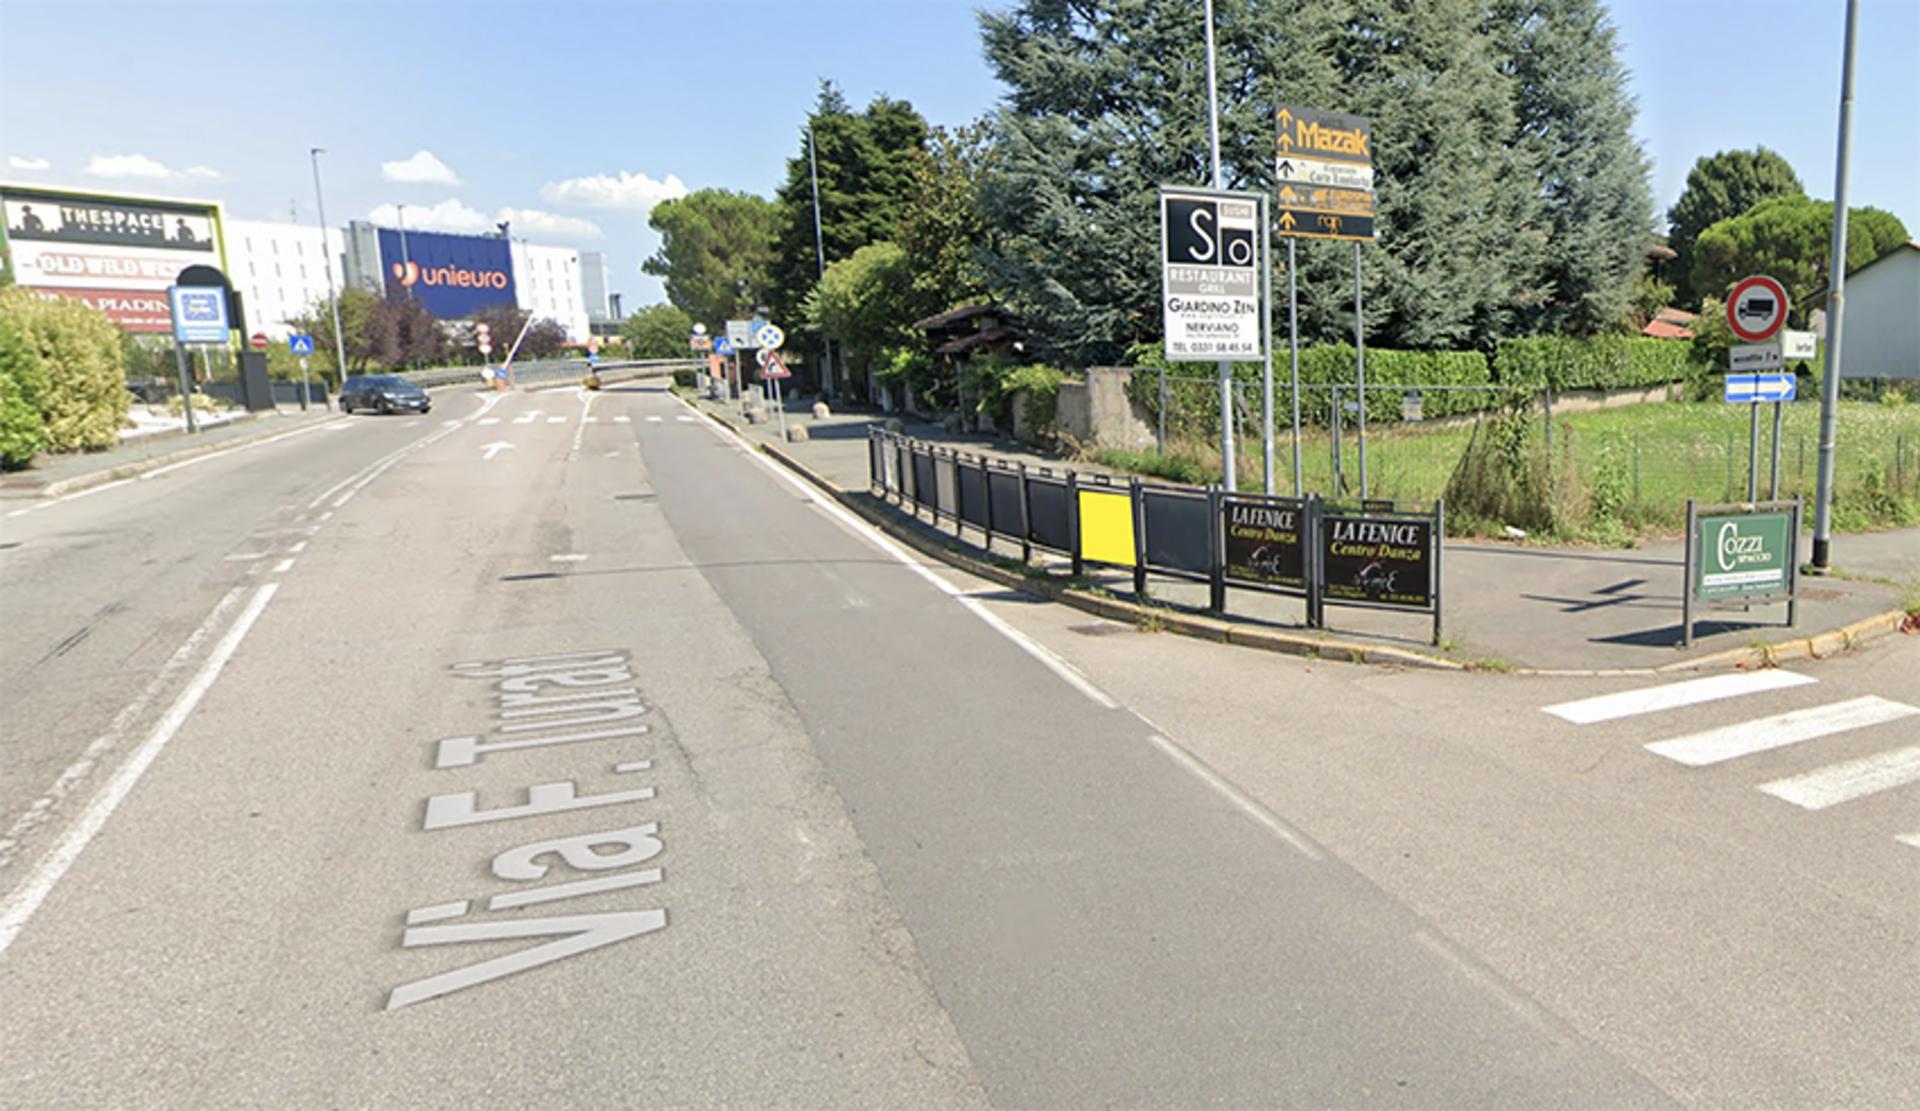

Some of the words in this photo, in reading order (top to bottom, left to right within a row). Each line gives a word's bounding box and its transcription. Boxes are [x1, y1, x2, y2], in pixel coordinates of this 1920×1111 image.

[1296, 119, 1370, 157] Mazak
[38, 254, 84, 273] OLD
[422, 263, 508, 289] unieuro
[1169, 269, 1251, 284] RESTAURANT
[1168, 298, 1231, 314] GIARDINO
[1185, 322, 1239, 334] NERVIANO
[1250, 508, 1296, 531] FENICE
[1230, 523, 1264, 539] Centro
[1264, 527, 1298, 544] Danza
[1357, 523, 1419, 545] FENICE
[1330, 541, 1376, 558] Centro
[1378, 543, 1422, 561] Danza
